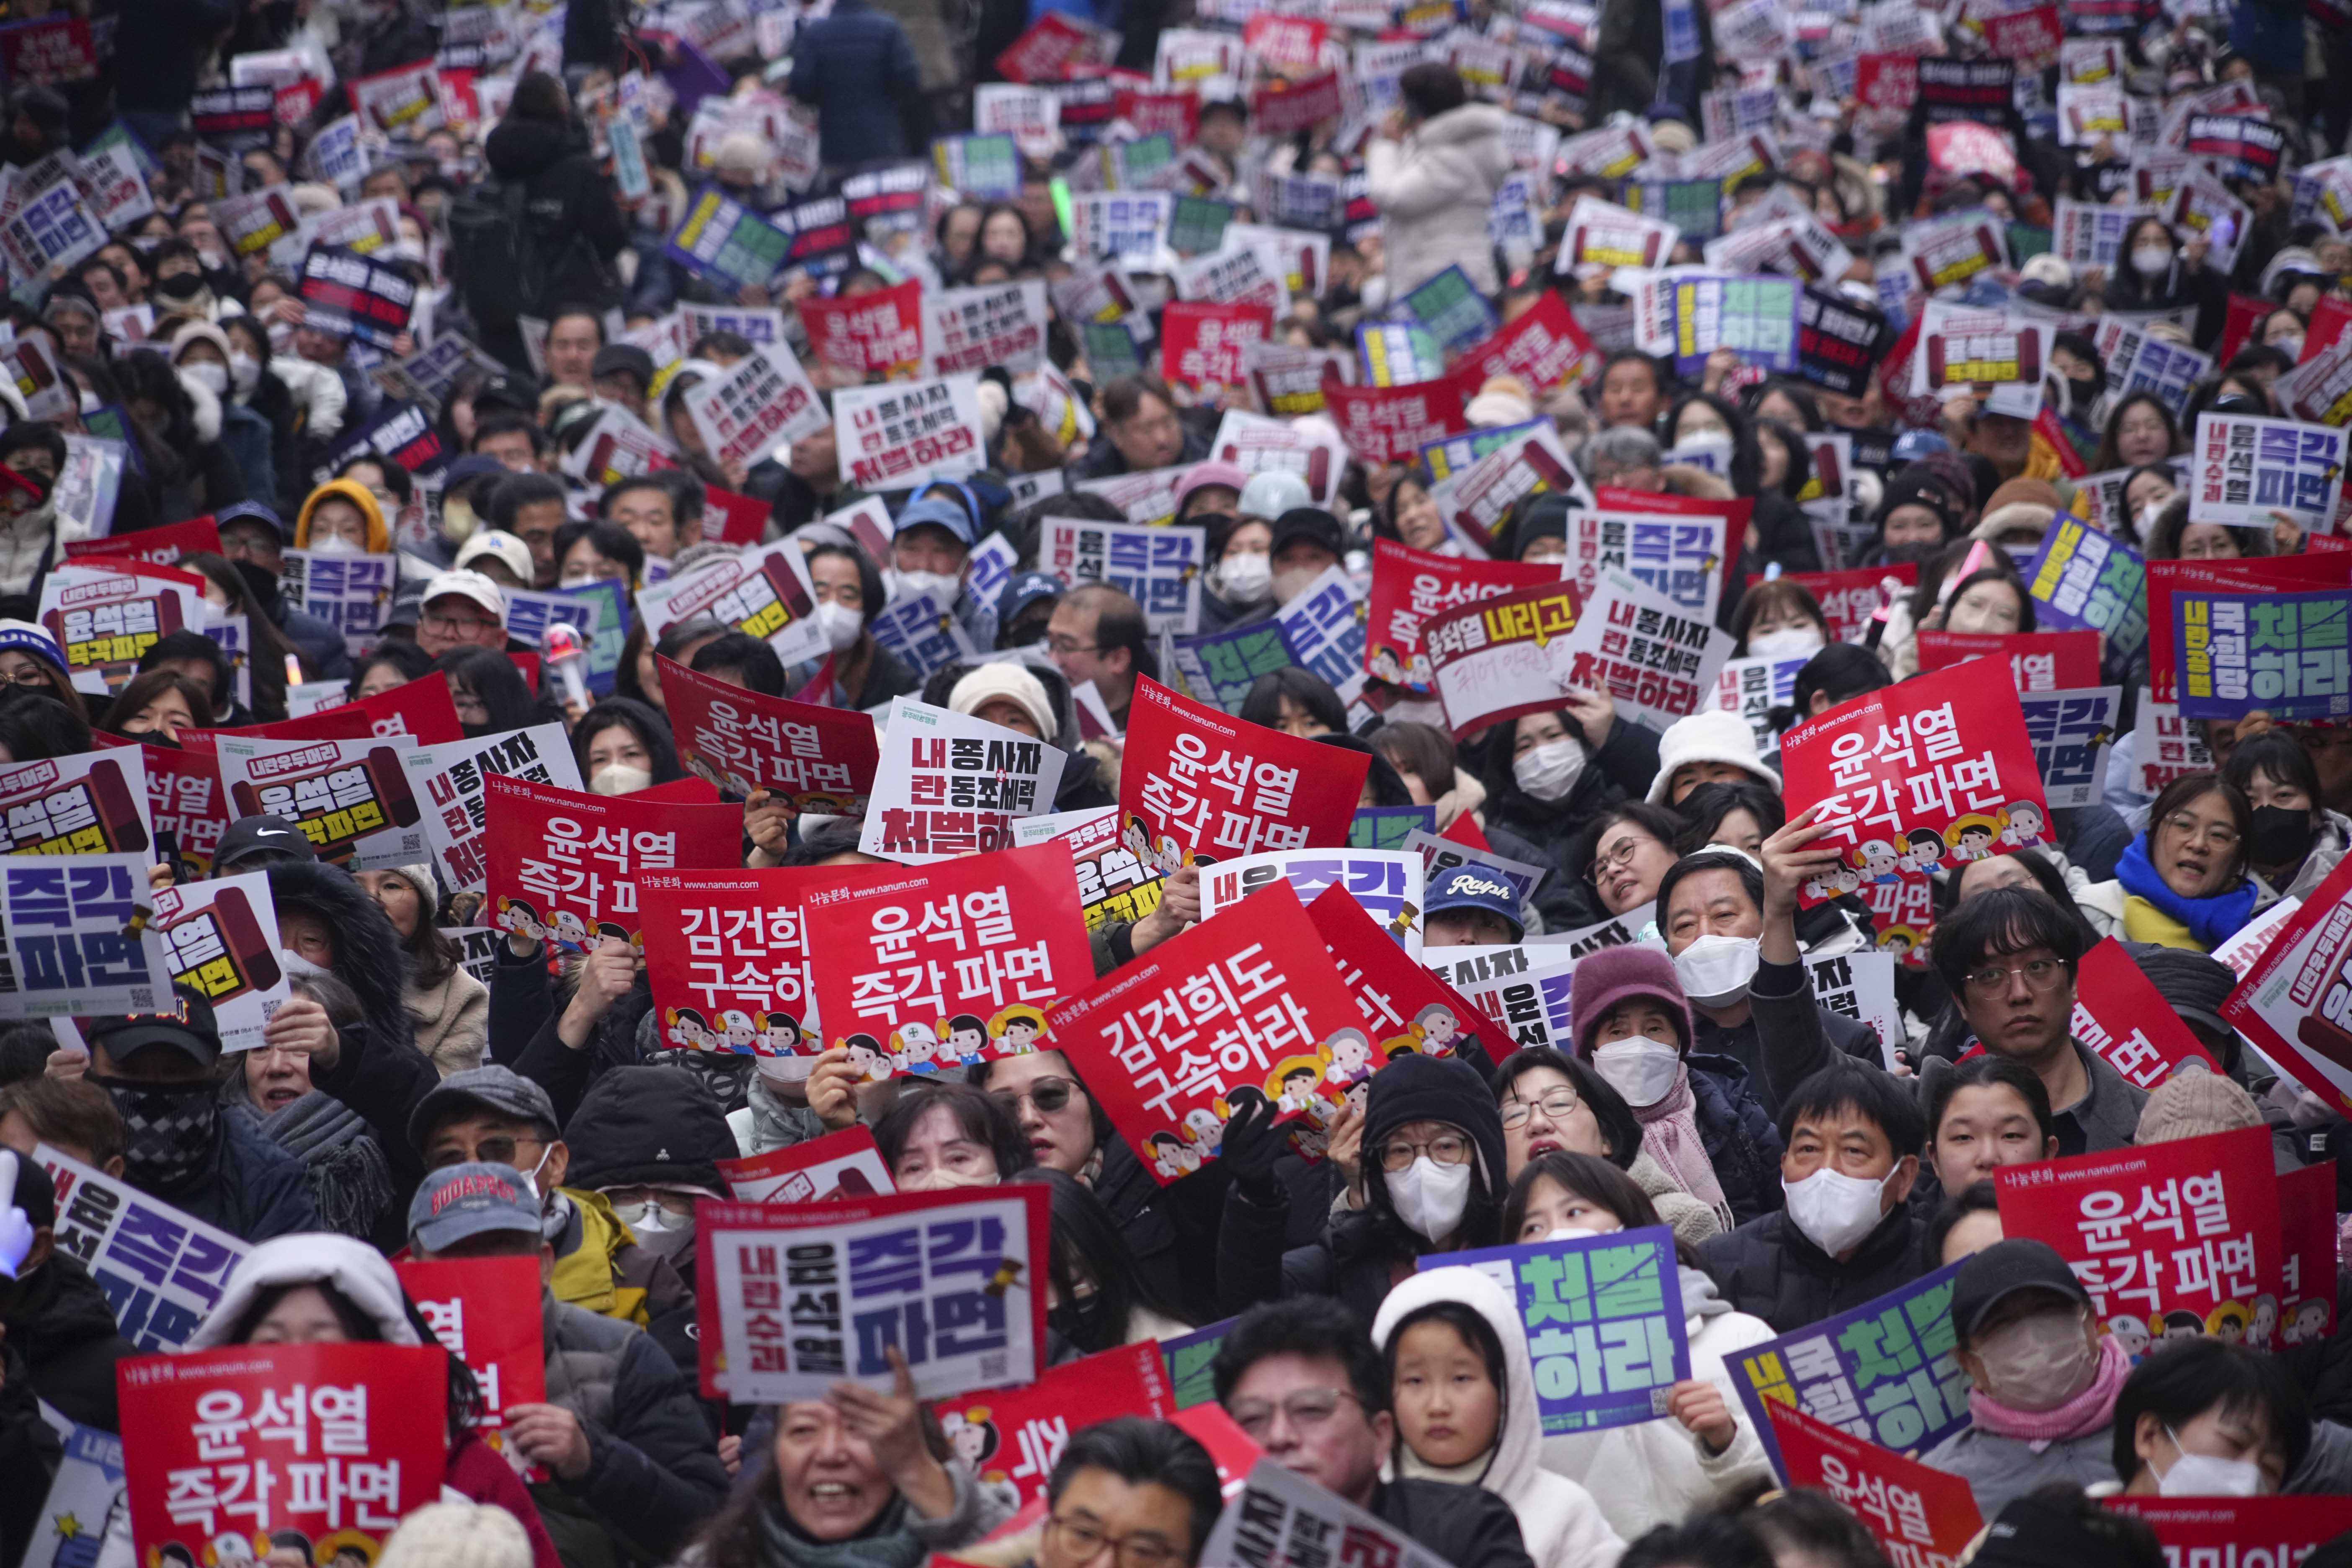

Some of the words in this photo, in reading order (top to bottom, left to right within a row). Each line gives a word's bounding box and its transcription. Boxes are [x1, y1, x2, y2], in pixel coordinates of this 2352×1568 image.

[2262, 426, 2339, 462] 즉각
[2255, 467, 2331, 511] 파면
[1110, 533, 1194, 574] 즉각
[1634, 524, 1713, 563] 즉각
[64, 599, 158, 643] 윤석열
[1485, 574, 1575, 643] 내리고
[1635, 606, 1710, 650] 종사자
[1628, 637, 1702, 679] 동조세력
[2213, 601, 2249, 700] 국힘당
[2251, 649, 2351, 699] 하라
[696, 679, 756, 704] www.nanum.com
[1141, 683, 1171, 709] 나눔문화
[1171, 704, 1236, 737] www.nanum.com
[1569, 651, 1698, 716] 처벌하라
[709, 700, 823, 759] 윤석열
[1786, 724, 1817, 749] 나눔문화
[1817, 701, 1882, 732] www.nanum.com
[1828, 702, 1964, 787] 윤석열
[249, 740, 339, 779] 내란우두머리
[449, 732, 539, 795] 종사자
[771, 755, 853, 793] 파면
[952, 738, 1041, 775] 종사자
[1168, 733, 1298, 817] 윤석열
[260, 765, 375, 821] 윤석열
[493, 781, 531, 798] 나눔문화
[534, 793, 606, 813] www.nanum.com
[951, 776, 1037, 812] 동조세력
[1141, 772, 1212, 848] 즉각
[1213, 810, 1310, 855] 파면
[1814, 780, 1903, 845] 즉각
[1906, 750, 2006, 817] 파면
[544, 817, 676, 873] 윤석열
[7, 866, 133, 928] 즉각
[518, 858, 604, 918] 즉각
[642, 876, 681, 889] 나눔문화
[684, 880, 758, 889] www.nanum.com
[810, 887, 850, 905] 나눔문화
[853, 877, 929, 898] www.nanum.com
[1446, 873, 1510, 900] Ralph
[681, 905, 810, 957] 김건희
[870, 885, 1016, 965] 윤석열
[2291, 905, 2352, 1003] 내란우두머리
[15, 931, 152, 990] 파면
[688, 960, 815, 1011] 구속하
[851, 959, 947, 1025] 즉각
[953, 940, 1057, 1006] 파면
[2228, 981, 2257, 1018] 나눔문화
[2257, 927, 2306, 986] www.nanum.com
[1052, 998, 1089, 1026] 나눔문화
[1090, 963, 1160, 1007] www.nanum.com
[1101, 942, 1287, 1072] 김건희도
[1133, 992, 1314, 1121] 구속하라
[431, 1175, 516, 1215] BUDAPEST
[2004, 1167, 2054, 1186] 나눔문화
[2058, 1159, 2146, 1182] www.nanum.com
[2077, 1171, 2230, 1253] 윤석열
[849, 1216, 1007, 1297] 즉각
[1519, 1242, 1663, 1328] 처벌
[2171, 1233, 2257, 1302] 파면
[738, 1245, 787, 1373] 내란수괴
[787, 1242, 845, 1375] 윤석열
[852, 1292, 1008, 1375] 파면
[178, 1359, 273, 1380] www.nanum.com
[1529, 1315, 1676, 1401] 하라
[191, 1382, 369, 1462] 윤석열
[165, 1457, 276, 1536] 즉각
[285, 1459, 400, 1539] 파면
